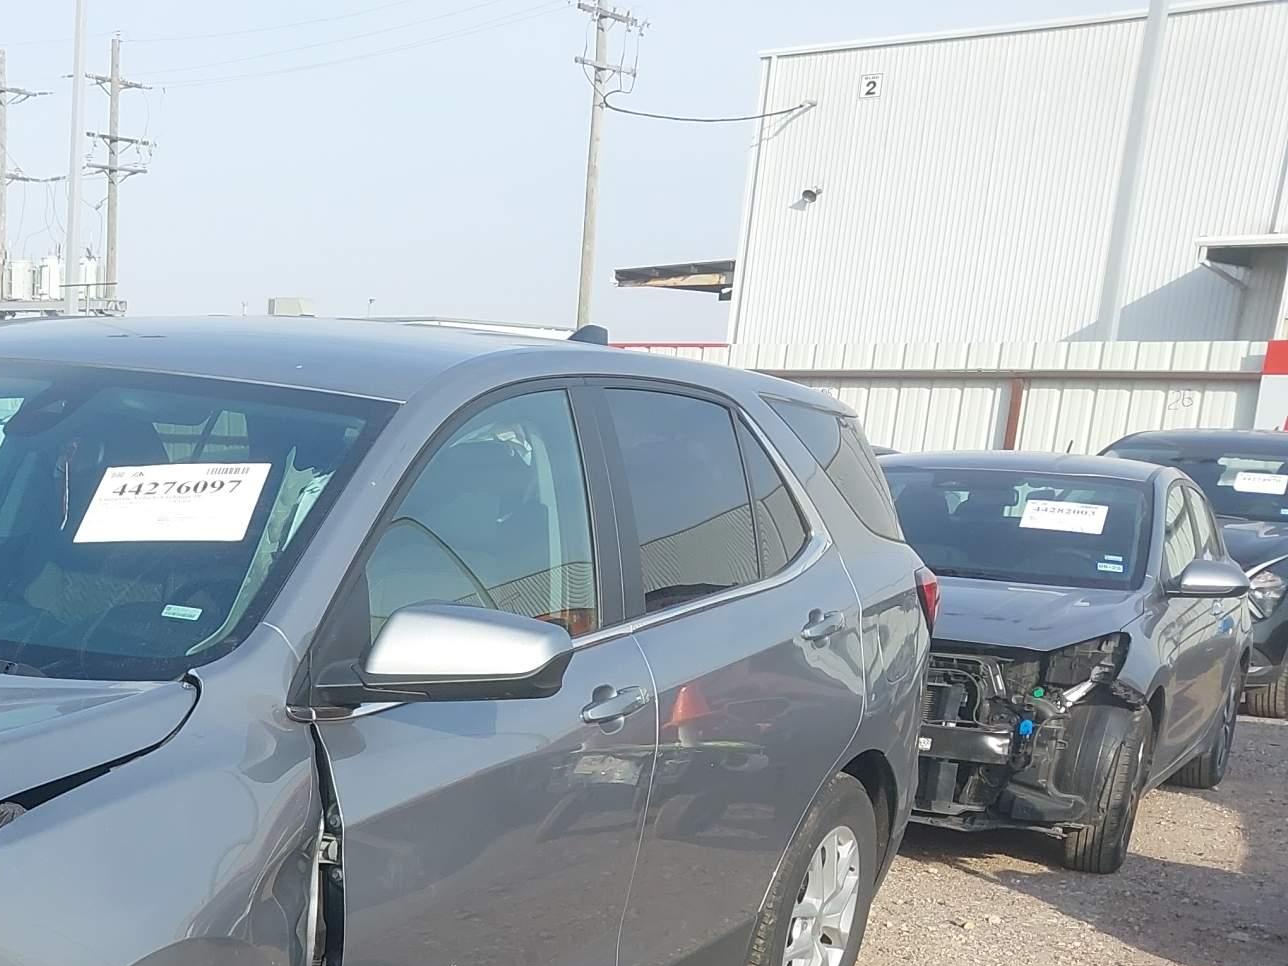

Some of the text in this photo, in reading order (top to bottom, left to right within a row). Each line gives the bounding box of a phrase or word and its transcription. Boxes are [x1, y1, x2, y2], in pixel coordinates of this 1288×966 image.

[865, 80, 877, 96] 2
[1167, 389, 1194, 411] 26
[112, 479, 243, 496] 44276097
